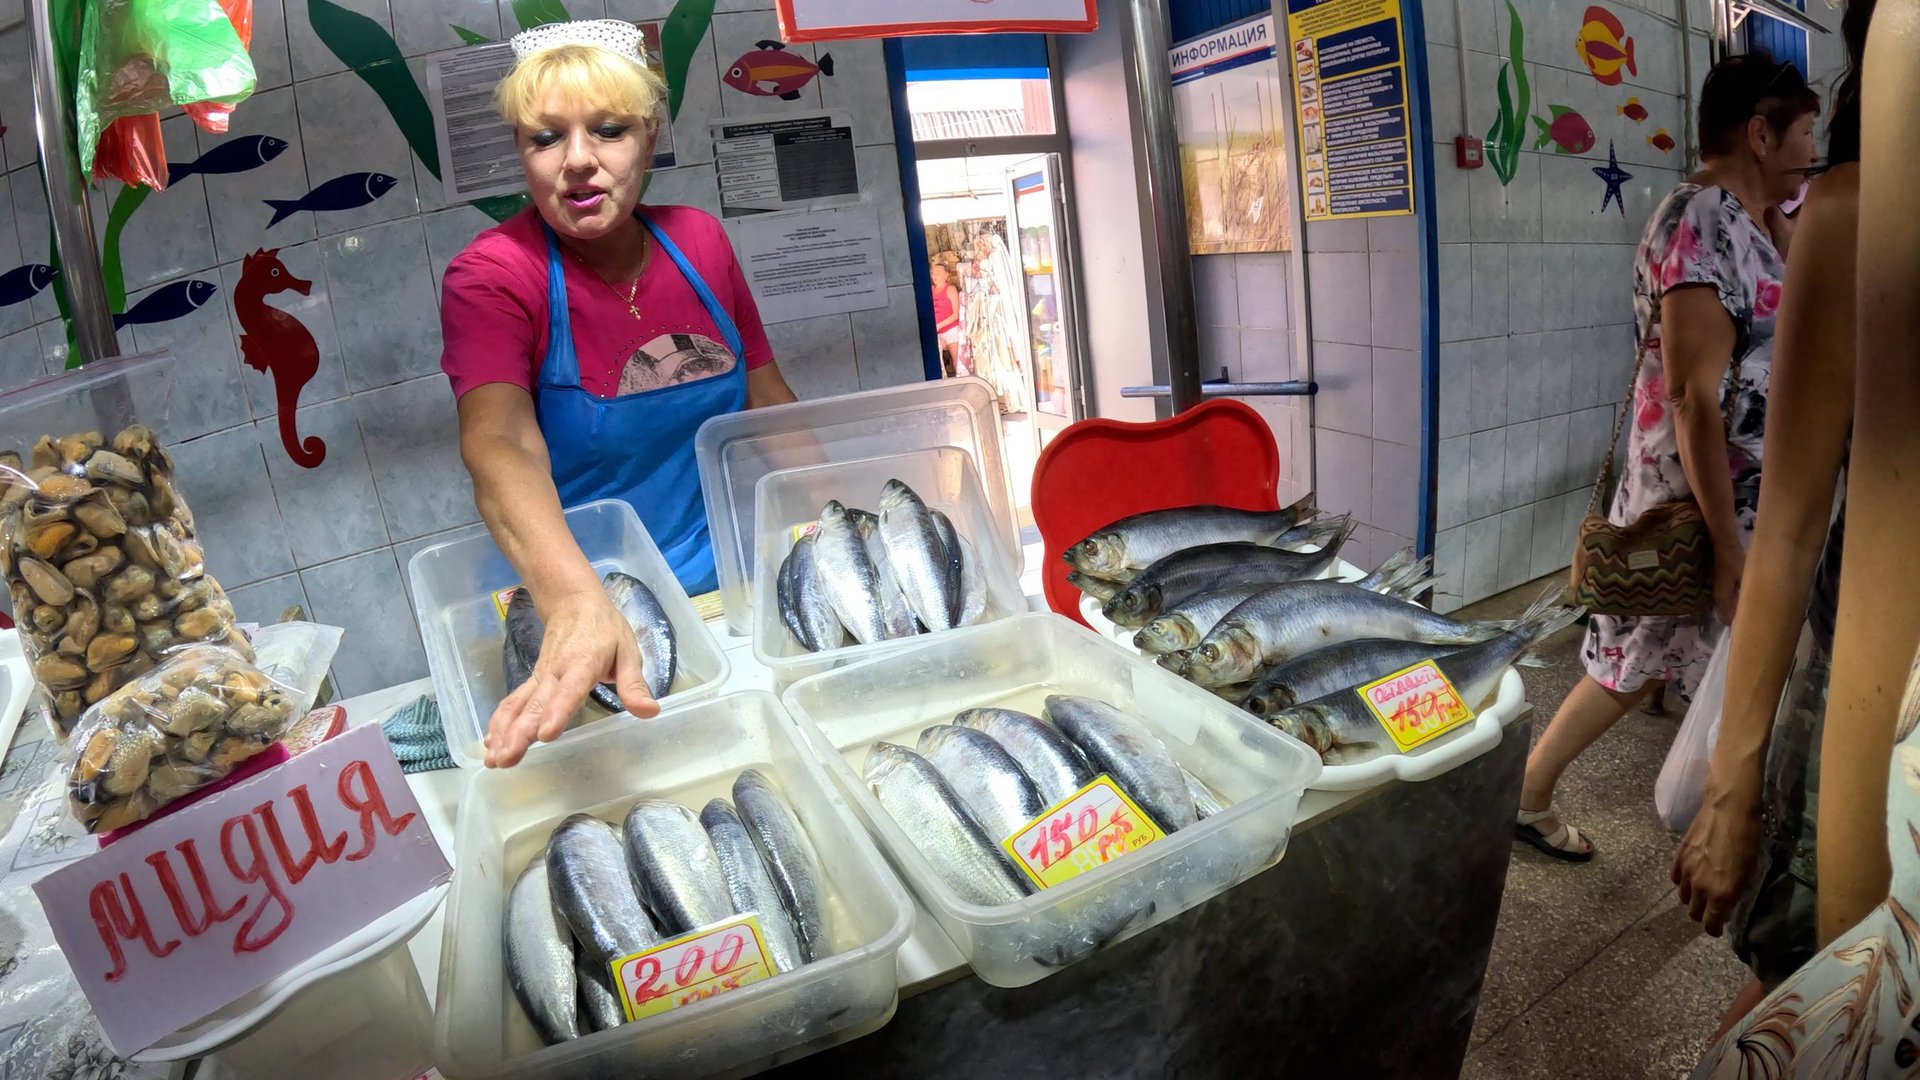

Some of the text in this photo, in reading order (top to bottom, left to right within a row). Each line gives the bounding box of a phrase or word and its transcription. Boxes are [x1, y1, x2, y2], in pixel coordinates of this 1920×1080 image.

[1172, 23, 1267, 68] ИНФОРМАЦИЯ
[1388, 691, 1438, 732] 150
[1028, 803, 1099, 870] 150
[634, 933, 745, 1006] 200
